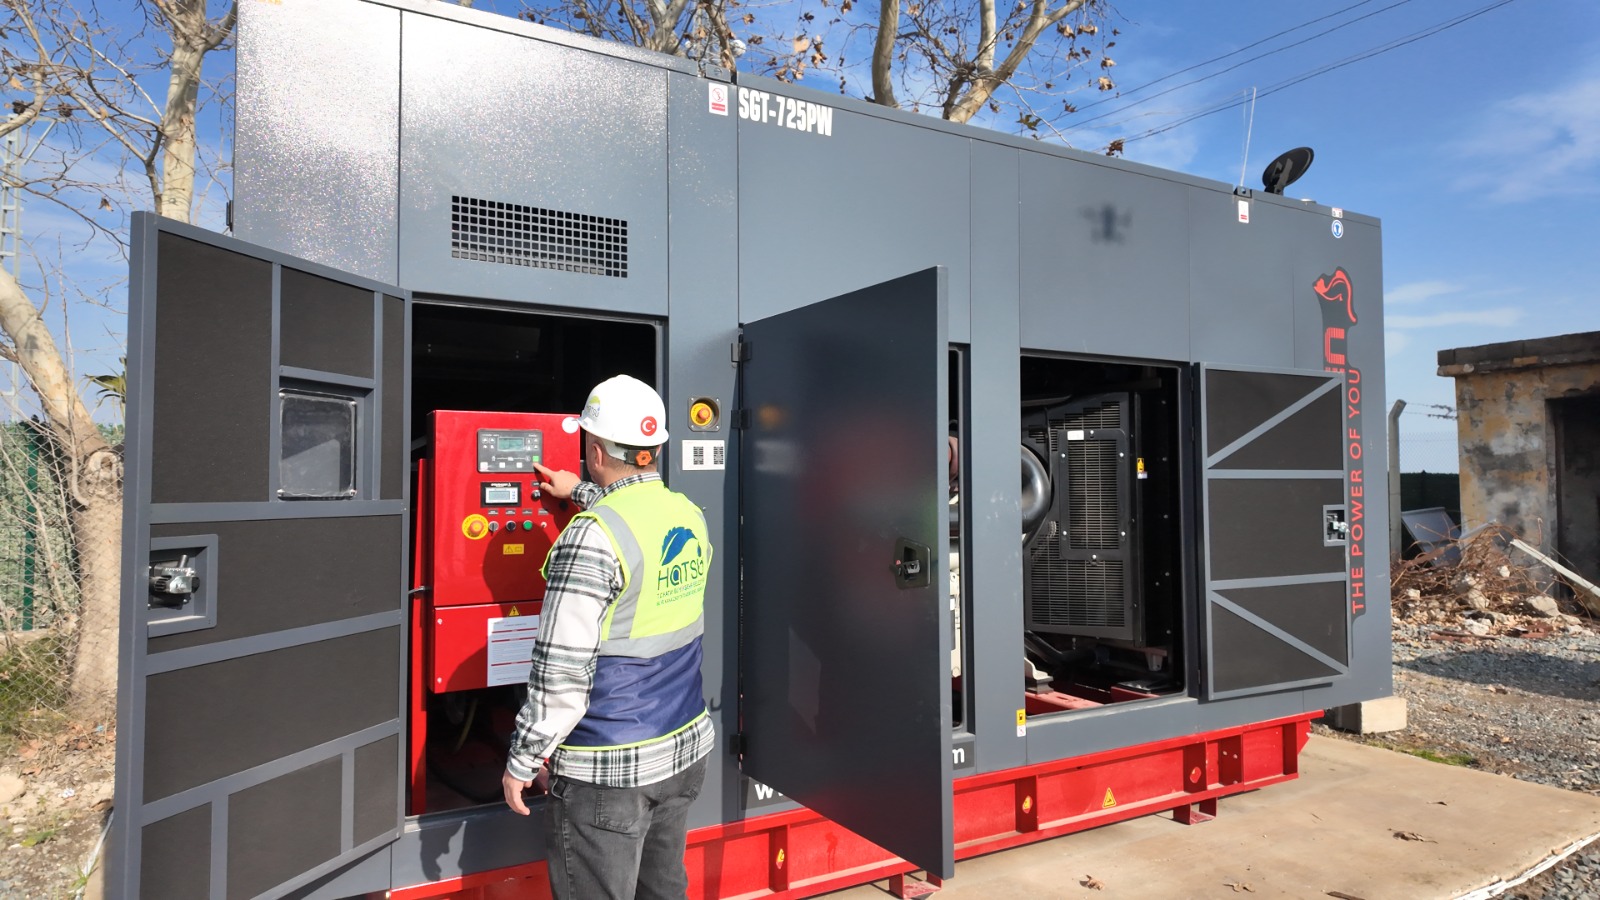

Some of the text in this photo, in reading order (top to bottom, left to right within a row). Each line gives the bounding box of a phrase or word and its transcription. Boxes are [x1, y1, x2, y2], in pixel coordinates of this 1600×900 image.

[739, 88, 832, 136] SGT-725PW
[1348, 369, 1364, 614] THE POWER OF YOU
